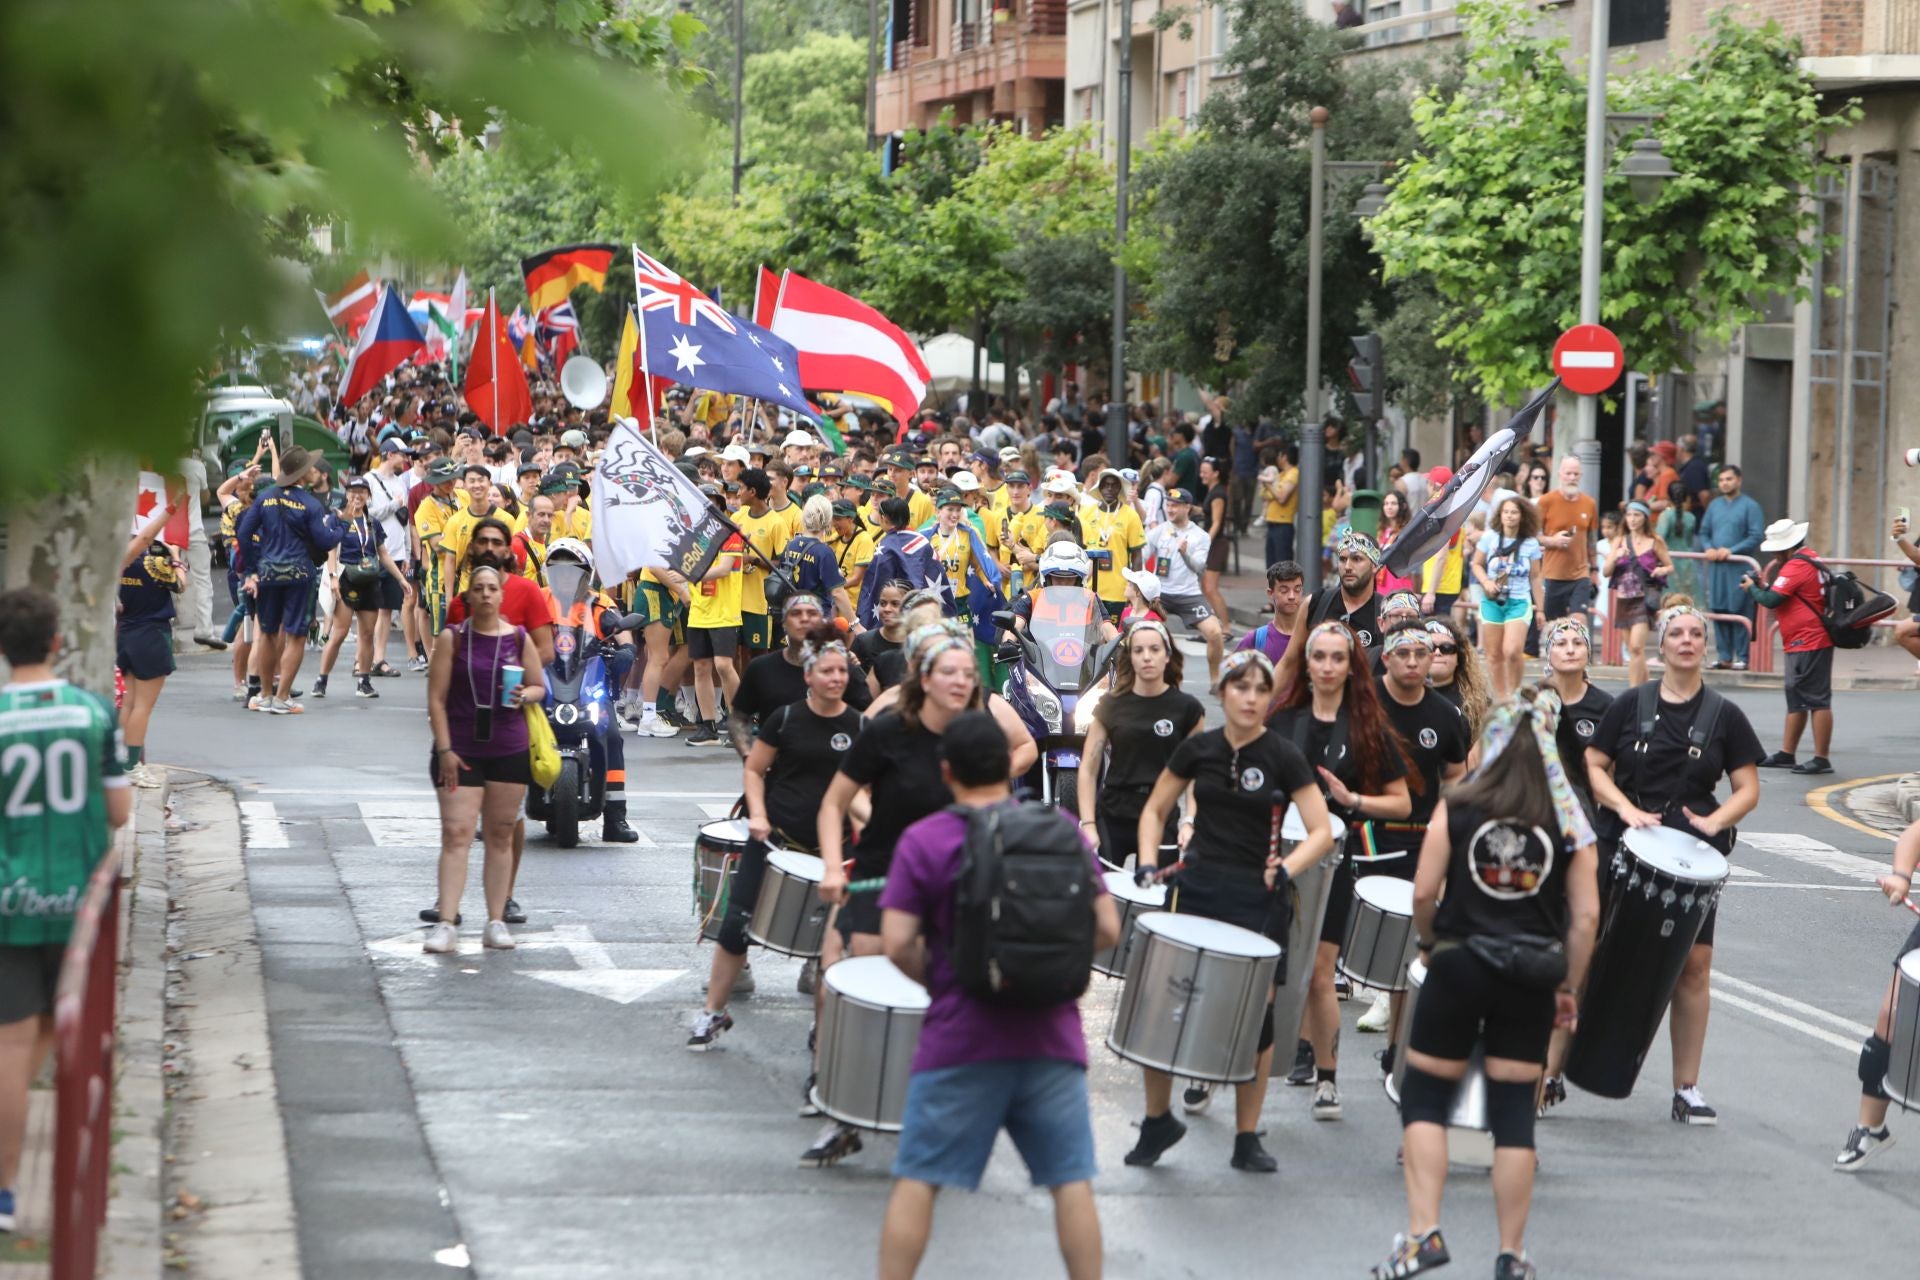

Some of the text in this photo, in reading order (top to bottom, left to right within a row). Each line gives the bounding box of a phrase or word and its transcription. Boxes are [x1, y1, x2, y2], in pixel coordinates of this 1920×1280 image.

[1192, 605, 1209, 619] 23
[752, 632, 761, 644] 8
[1, 739, 88, 818] 20
